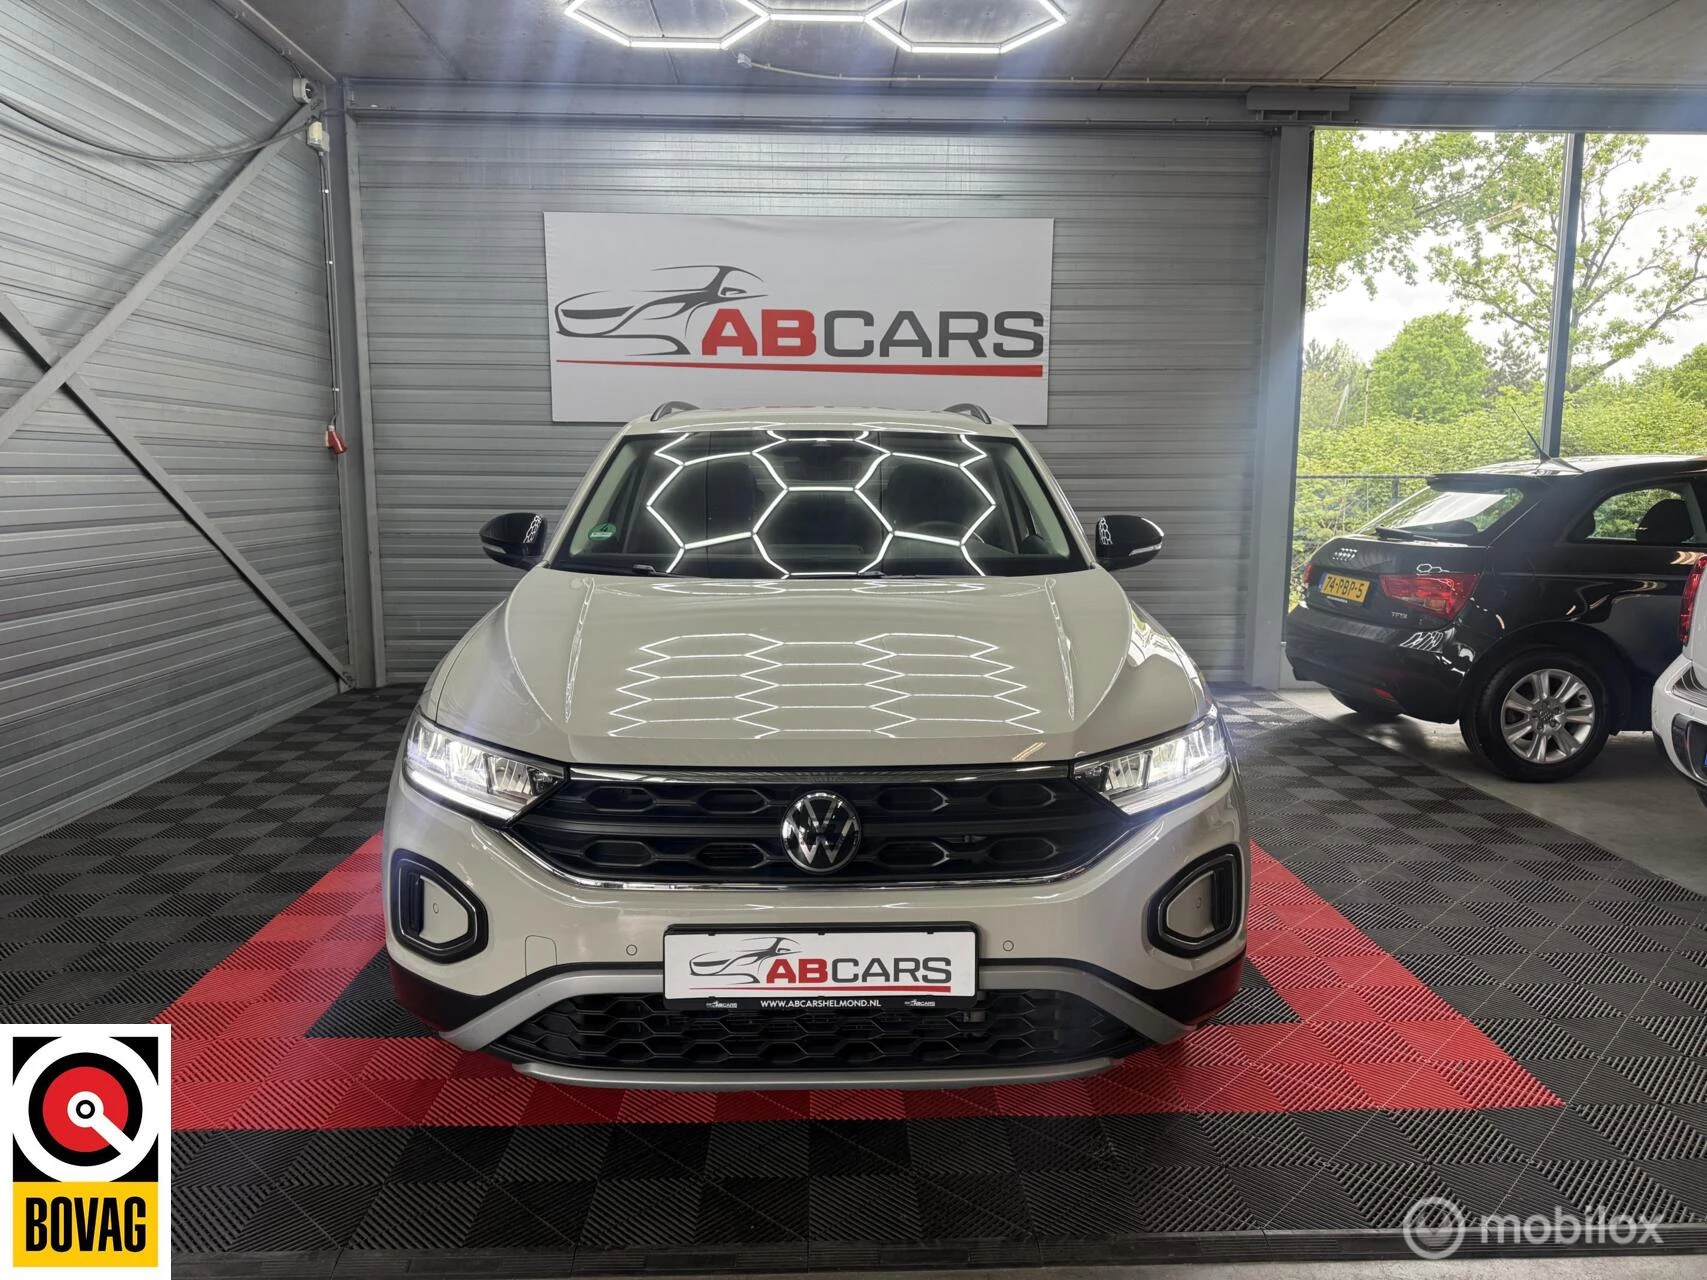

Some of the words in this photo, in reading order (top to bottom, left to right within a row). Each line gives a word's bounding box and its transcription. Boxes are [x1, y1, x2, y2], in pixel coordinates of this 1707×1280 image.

[701, 308, 1044, 358] ABCARS
[1324, 576, 1364, 598] 74-PBP-5
[766, 957, 952, 984] ABCARS
[760, 999, 882, 1008] WWW.ABCARSHELMOND.NL
